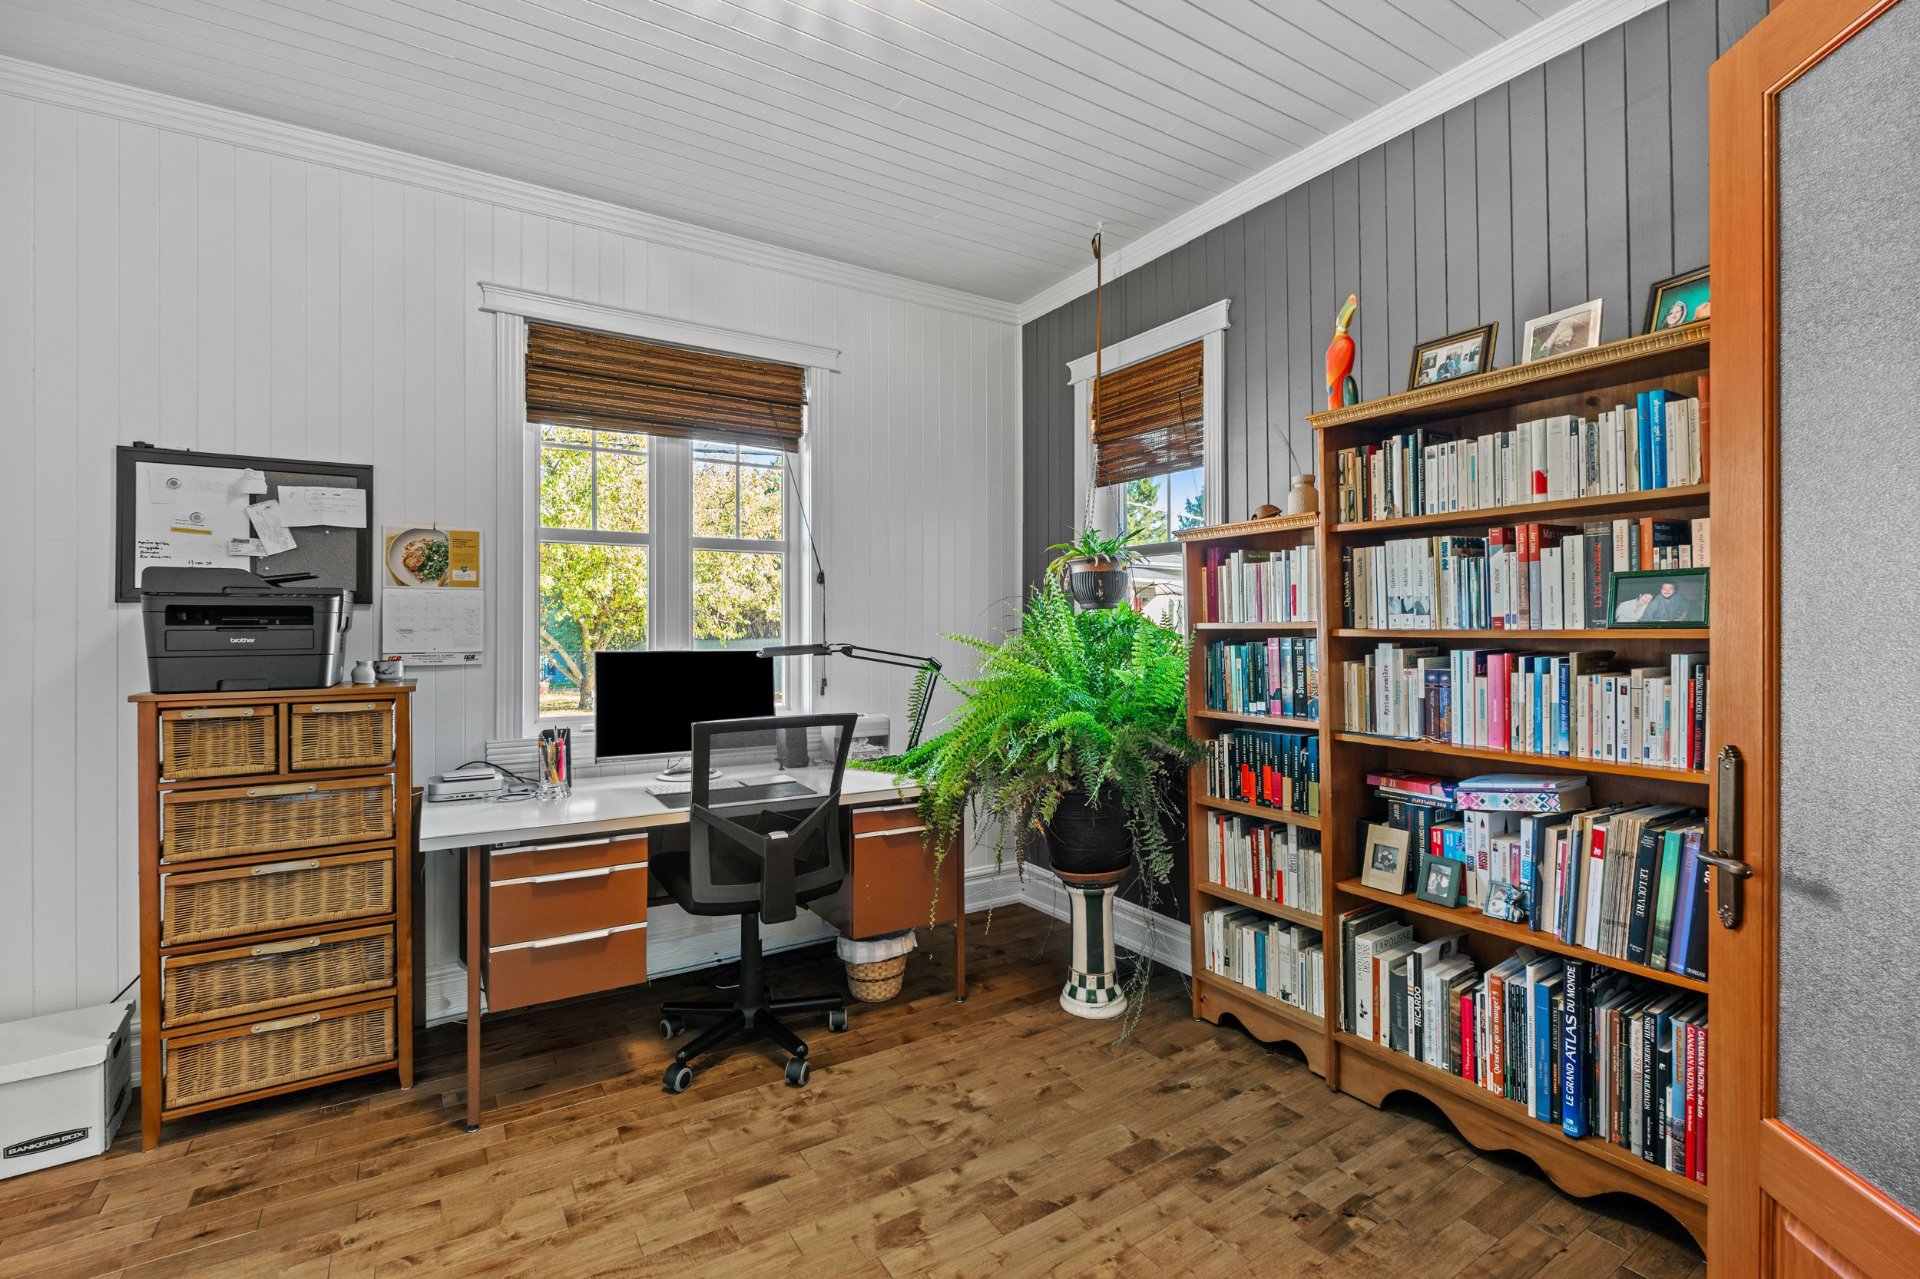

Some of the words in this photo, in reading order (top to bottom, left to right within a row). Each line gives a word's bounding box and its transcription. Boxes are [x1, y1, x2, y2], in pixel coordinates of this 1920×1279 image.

[1382, 664, 1390, 692] première
[1478, 851, 1488, 870] MUSSO
[1636, 880, 1648, 918] LOUVRE
[1374, 930, 1412, 953] LAROUSSE
[1566, 965, 1576, 998] MONDE
[1414, 986, 1422, 1027] RICARDO
[1565, 1015, 1577, 1063] ATLAS
[1643, 1011, 1651, 1036] NORTH
[1643, 1036, 1651, 1071] AMERICAN
[1686, 1023, 1695, 1061] CANADIAN
[1697, 1027, 1706, 1063] CANADIAN
[1493, 1044, 1501, 1074] Qu'est-ce
[1565, 1063, 1575, 1094] GRAND
[1643, 1071, 1651, 1108] RAILROADS
[1686, 1061, 1695, 1099] NATIONAL
[1697, 1063, 1706, 1090] PACIFIC
[8, 1138, 60, 1155] BANKERS
[61, 1131, 84, 1142] BOX
